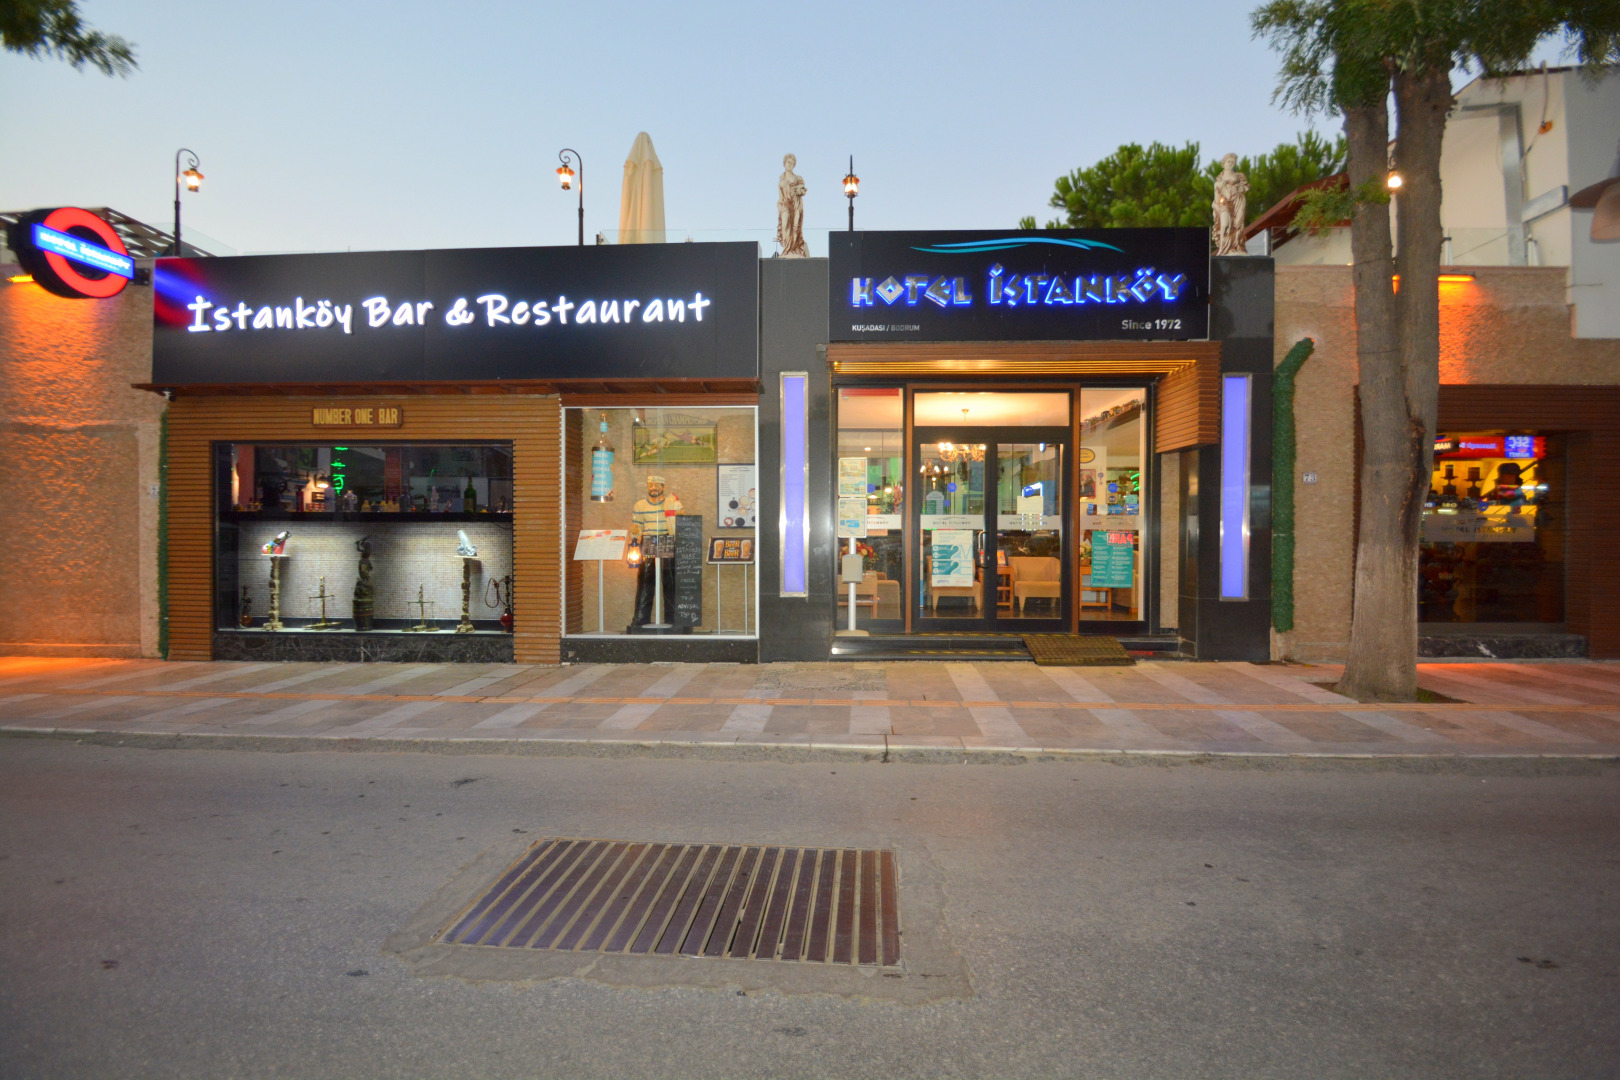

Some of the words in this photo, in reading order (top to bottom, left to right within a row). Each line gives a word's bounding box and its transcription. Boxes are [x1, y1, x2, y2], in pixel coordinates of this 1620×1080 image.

[852, 274, 972, 307] HOTEL
[187, 295, 353, 334] İstanköy
[361, 296, 434, 329] Bar
[445, 297, 475, 326] &
[476, 292, 711, 328] Restaurant
[891, 324, 920, 332] BODRUM
[1121, 319, 1152, 330] Since
[1154, 319, 1182, 330] 1972
[313, 408, 352, 425] NUMBER
[354, 408, 373, 425] ONE
[378, 408, 399, 425] BAR
